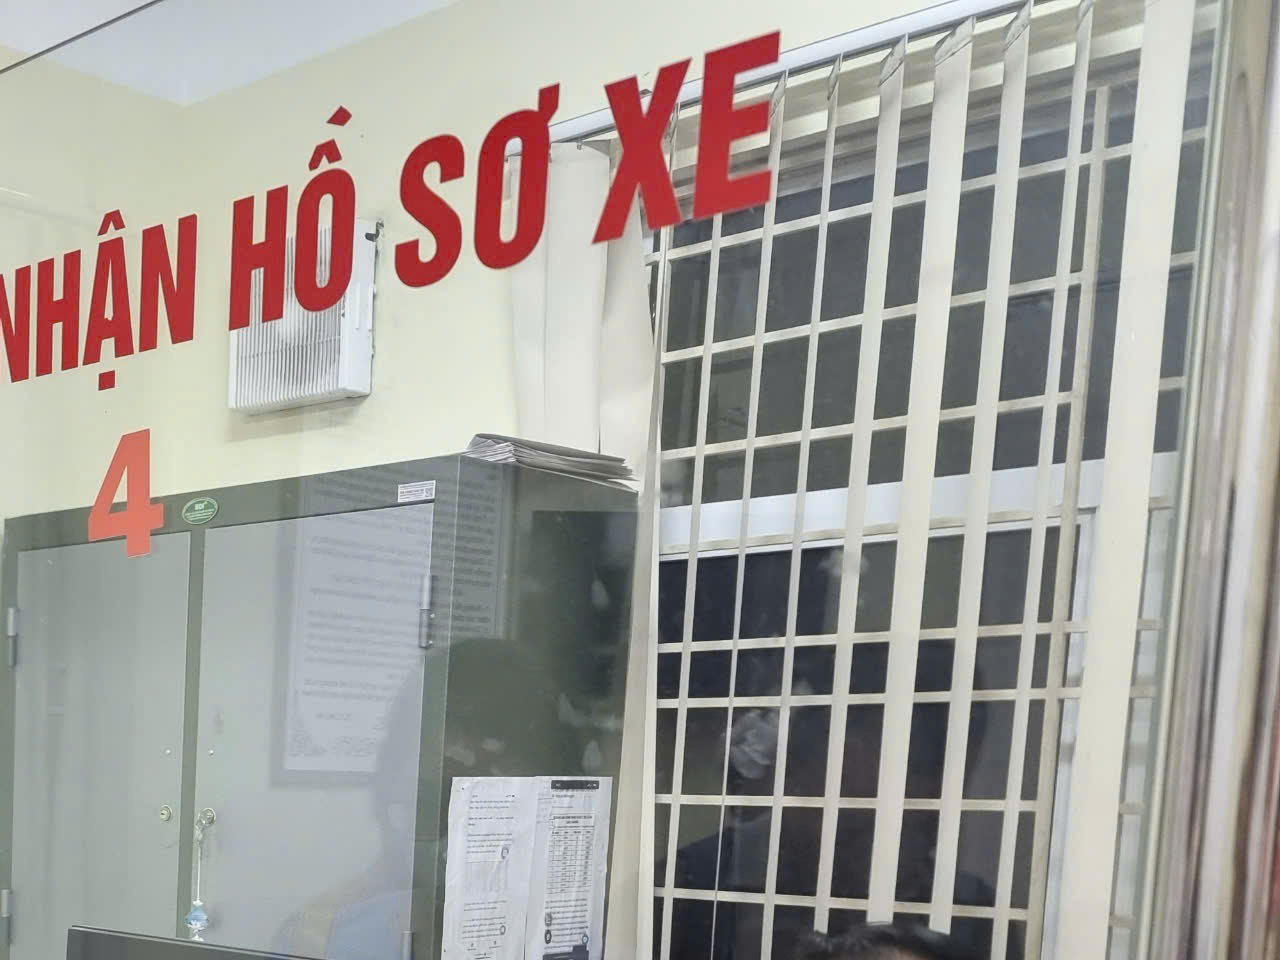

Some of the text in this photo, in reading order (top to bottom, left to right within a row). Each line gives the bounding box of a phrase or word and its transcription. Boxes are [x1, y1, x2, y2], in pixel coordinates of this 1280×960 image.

[394, 84, 561, 288] SƠ
[591, 30, 781, 244] XE
[87, 428, 165, 558] 4
